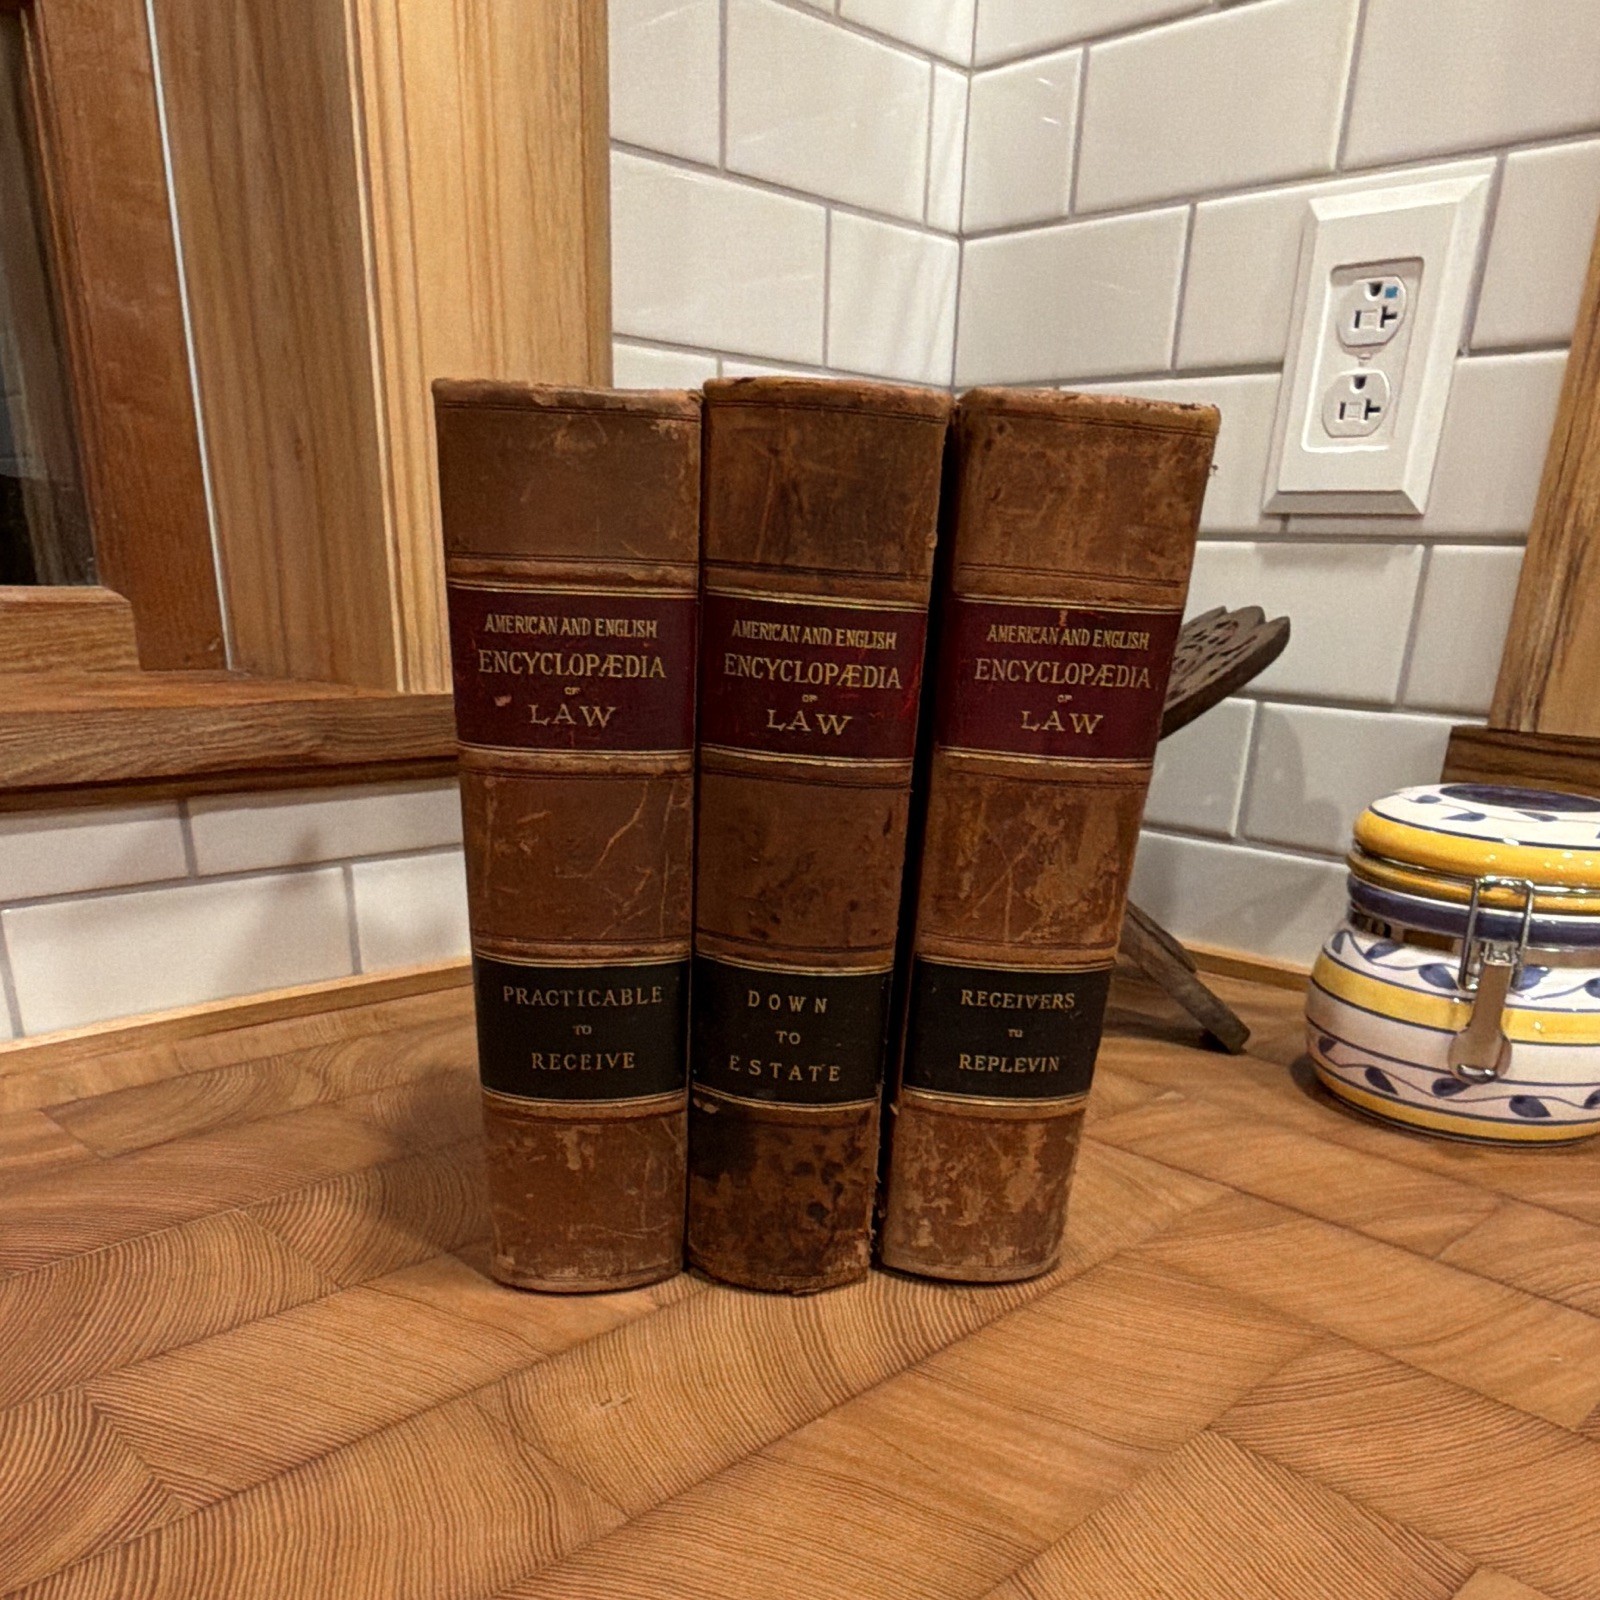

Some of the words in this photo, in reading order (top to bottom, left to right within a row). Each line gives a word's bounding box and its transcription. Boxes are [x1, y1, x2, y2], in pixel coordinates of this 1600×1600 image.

[484, 613, 558, 635] AMERICAN
[560, 617, 591, 636] AND
[595, 618, 658, 639] ENGLISH
[731, 619, 800, 643] AMERICAN
[802, 626, 832, 646] AND
[835, 628, 897, 650] ENGLISH
[987, 624, 1059, 645] AMERICAN
[1059, 628, 1090, 647] AND
[1092, 629, 1150, 650] ENGLISH
[478, 649, 666, 678] ENCYCLOPÆDIA
[724, 652, 902, 689] ENCYCLOPÆDIA
[974, 658, 1151, 689] ENCYCLOPÆDIA
[564, 686, 581, 696] OF
[802, 694, 818, 703] OF
[1057, 694, 1073, 703] OF
[529, 703, 617, 729] LAW
[766, 709, 853, 736] LAW
[1021, 710, 1103, 735] LAW
[503, 985, 663, 1007] PRACTICABLE
[748, 989, 828, 1014] DOWN
[960, 989, 1075, 1010] RECEIVERS
[572, 1024, 592, 1036] TO
[775, 1030, 801, 1045] TO
[531, 1052, 635, 1070] RECEIVE
[729, 1054, 841, 1082] ESTATE
[959, 1053, 1060, 1074] REPLEVIN
